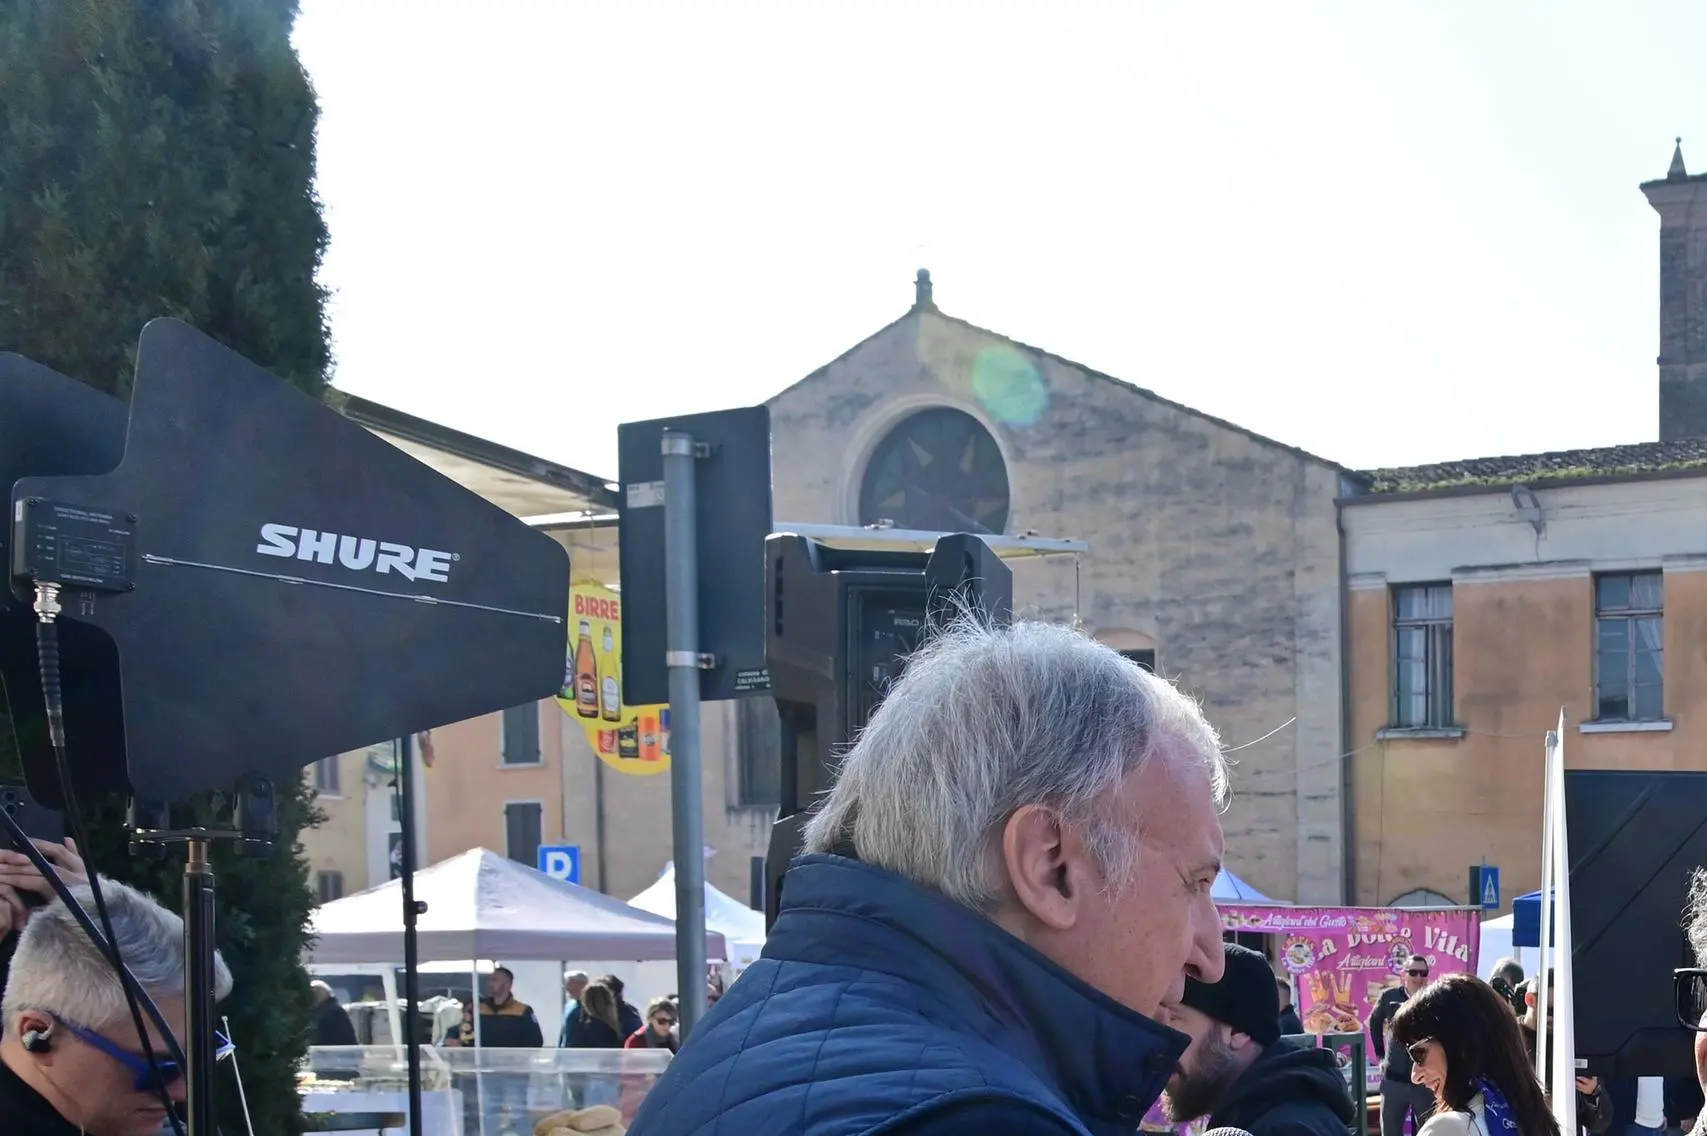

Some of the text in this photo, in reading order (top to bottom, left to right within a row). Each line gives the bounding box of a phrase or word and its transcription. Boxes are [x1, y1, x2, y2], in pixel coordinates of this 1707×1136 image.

[257, 523, 451, 582] SHURE
[575, 594, 619, 621] BIRRE
[546, 851, 572, 880] P
[1424, 926, 1469, 962] Vita
